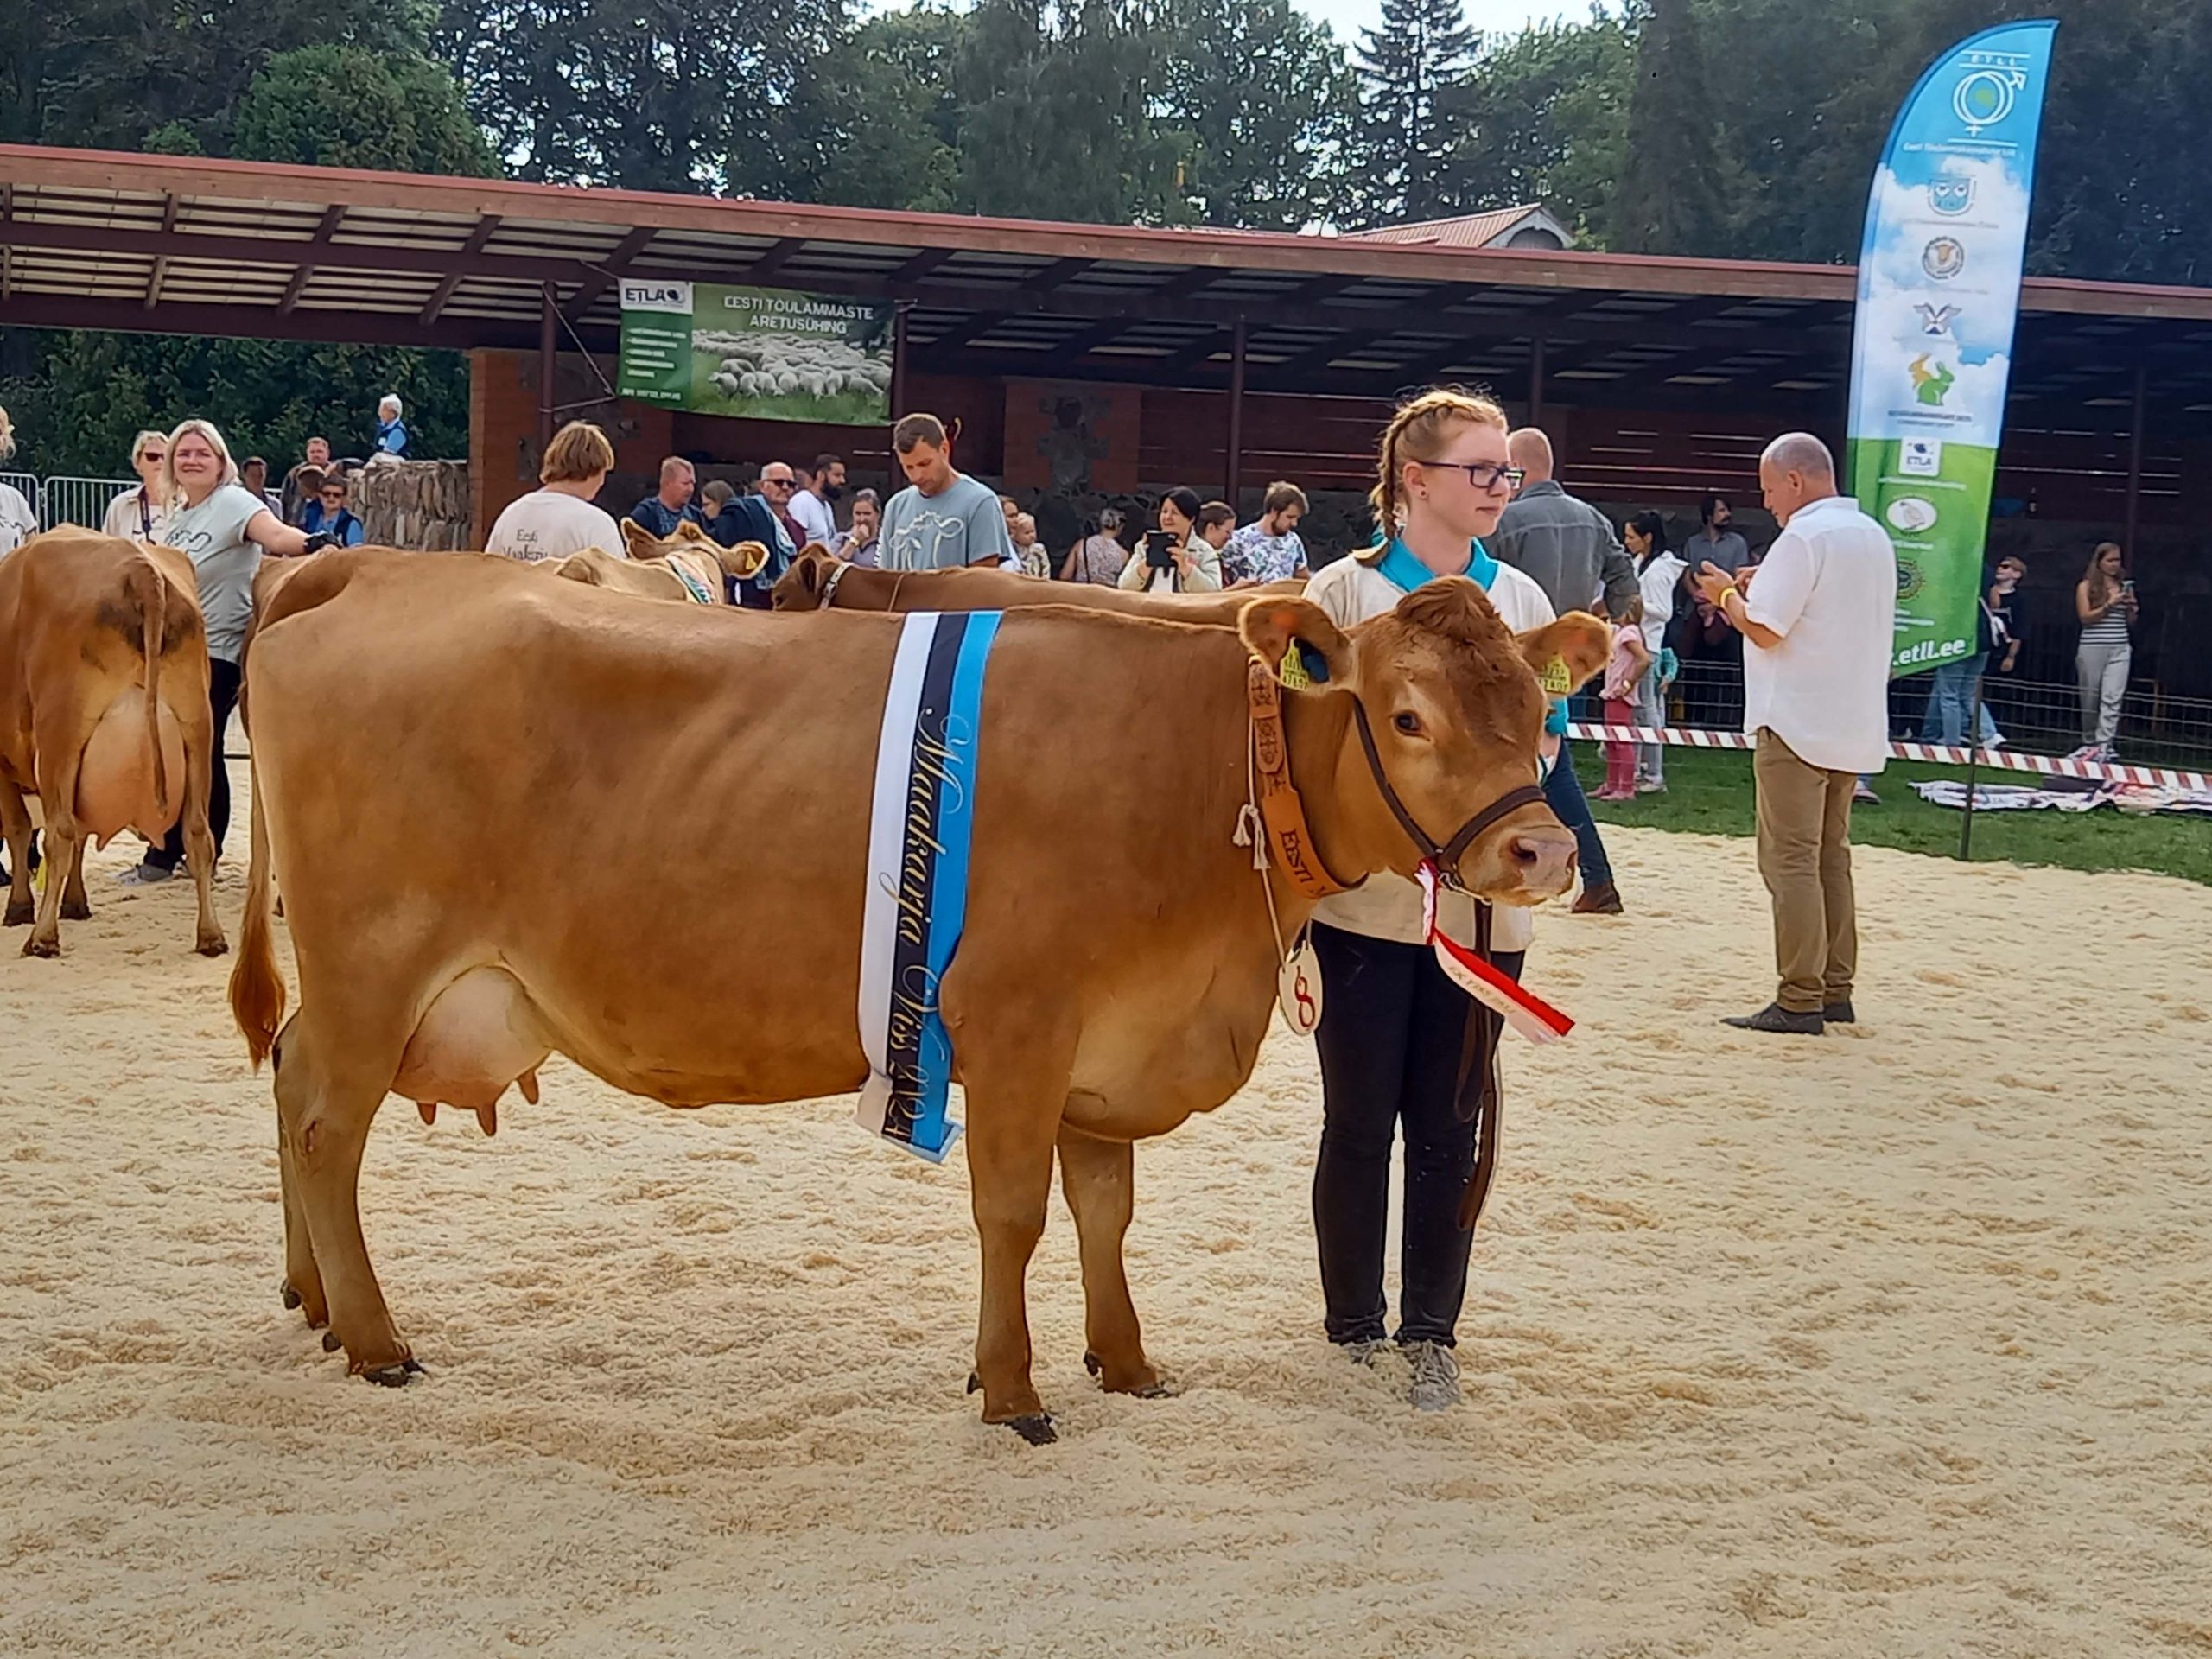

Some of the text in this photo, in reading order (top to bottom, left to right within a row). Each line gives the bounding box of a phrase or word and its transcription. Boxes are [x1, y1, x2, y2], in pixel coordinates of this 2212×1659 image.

[625, 288, 665, 303] ETLA
[724, 296, 874, 321] EESTI TÕULAMMASTE
[749, 315, 847, 334] ARETUSÜHING
[1892, 639, 1966, 666] .etll.ee
[878, 707, 972, 946] Maakarja
[1294, 964, 1316, 1028] 8
[890, 963, 946, 1062] Viss
